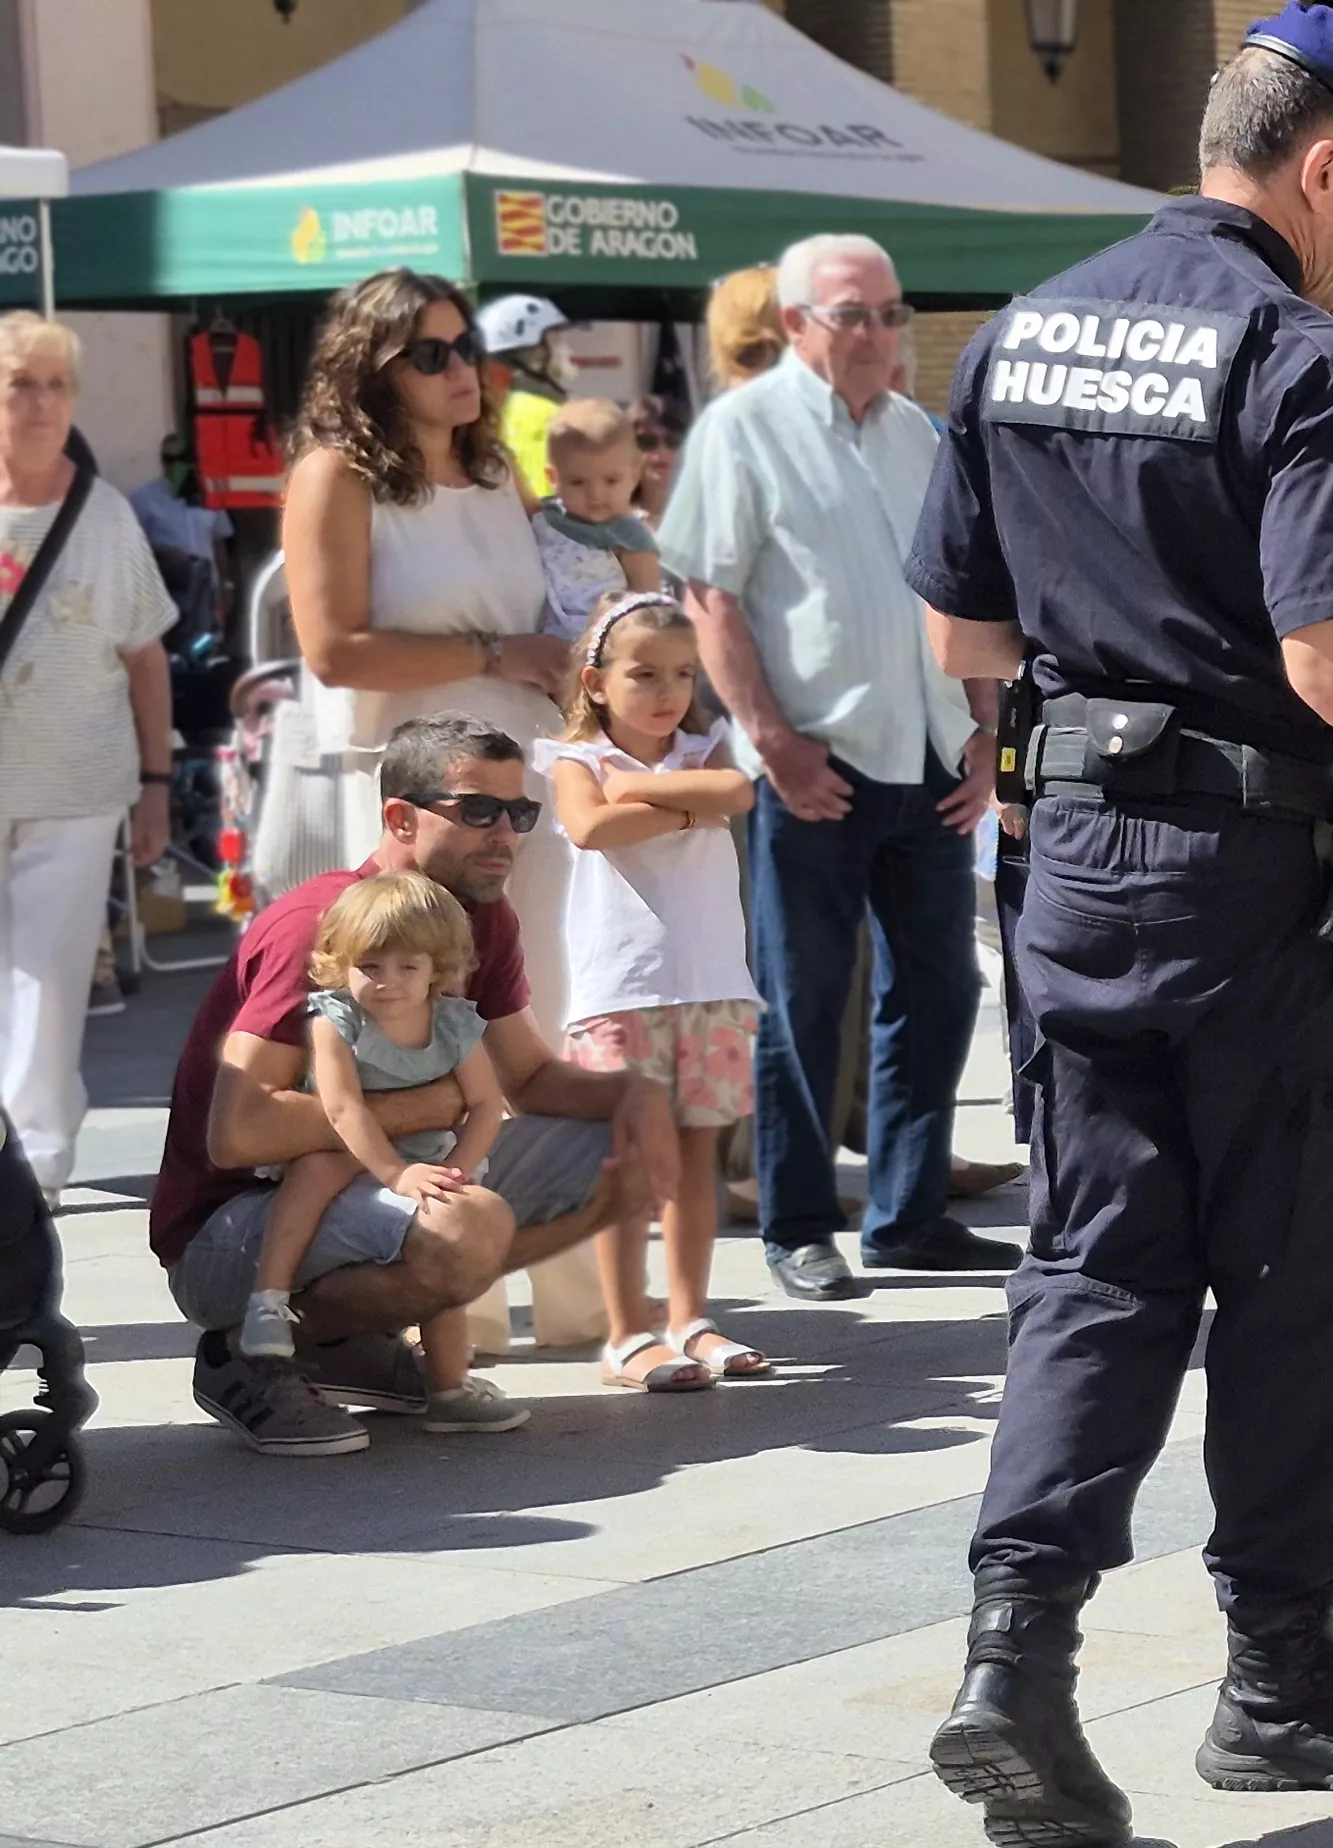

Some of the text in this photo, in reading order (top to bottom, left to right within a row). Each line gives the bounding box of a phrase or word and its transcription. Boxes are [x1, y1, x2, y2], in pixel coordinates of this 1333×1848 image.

[683, 113, 904, 148] INFOAR
[331, 205, 438, 243] INFOAR
[548, 195, 678, 229] GOBIERNO
[548, 226, 698, 260] DE ARAGON
[1002, 311, 1218, 369] POLICIA
[991, 360, 1207, 423] HUESCA
